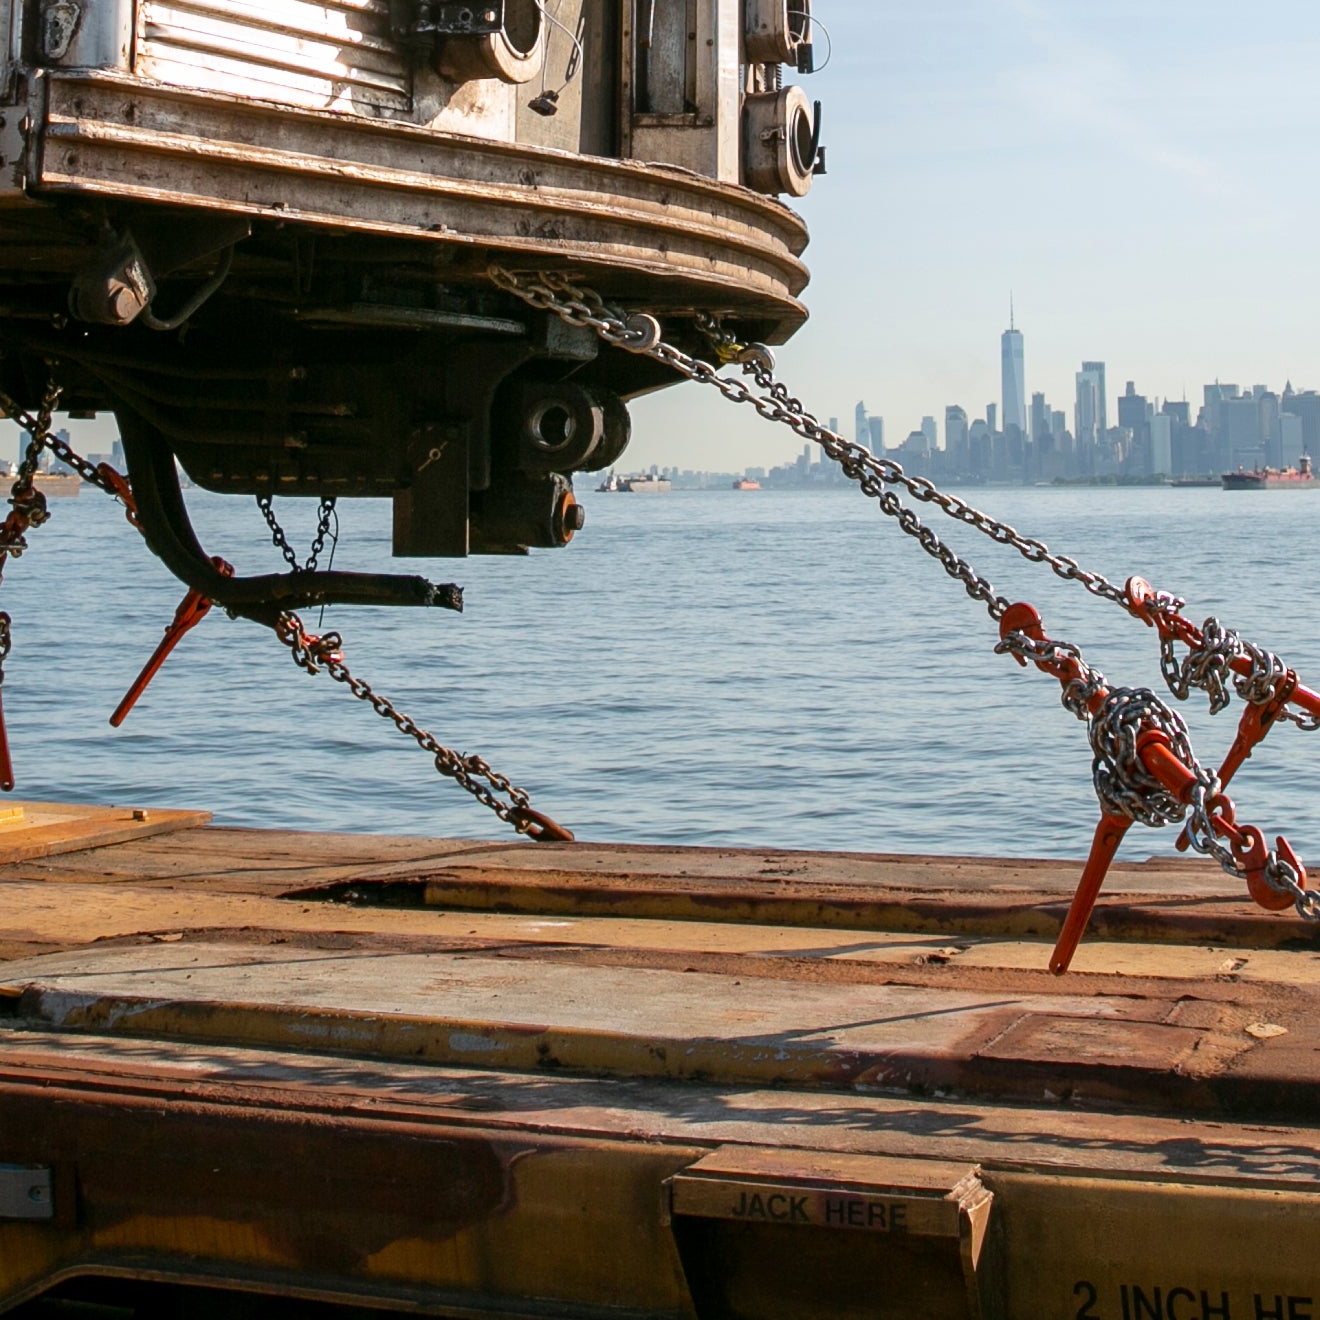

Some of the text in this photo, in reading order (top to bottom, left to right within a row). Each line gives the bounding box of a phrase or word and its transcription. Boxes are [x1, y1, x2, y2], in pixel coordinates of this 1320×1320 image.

[731, 1192, 908, 1233] JACK HERE
[1073, 1280, 1100, 1320] 2
[1119, 1284, 1230, 1320] INCH
